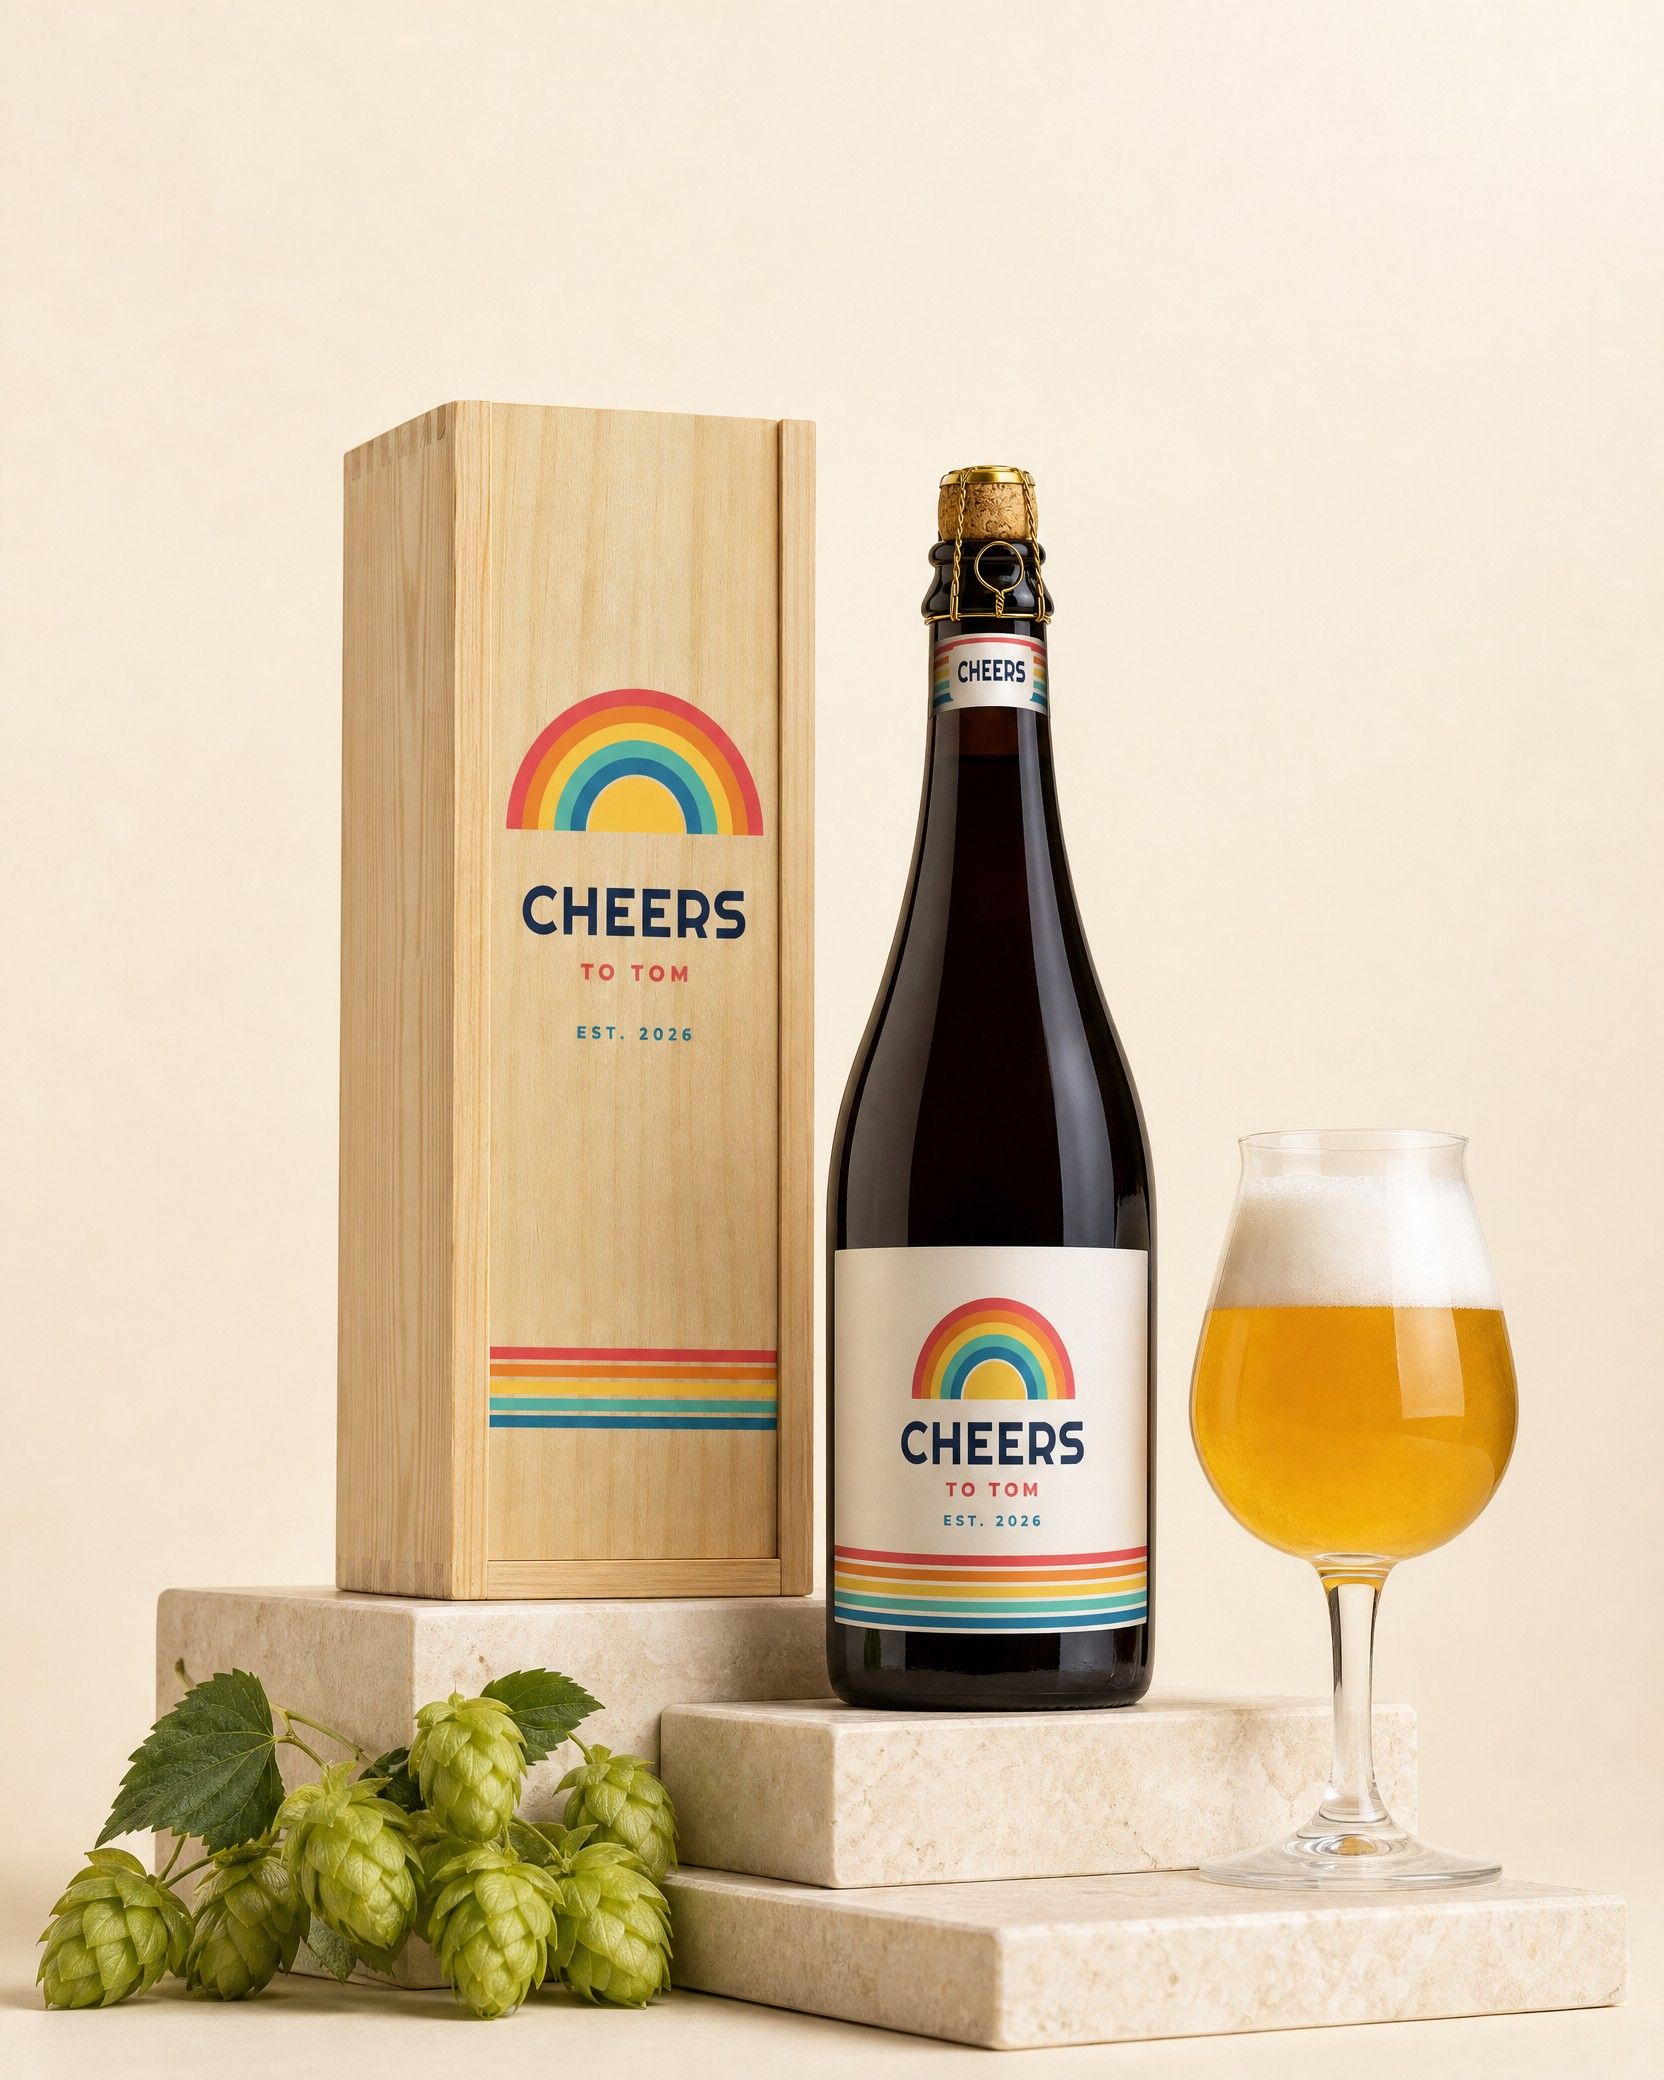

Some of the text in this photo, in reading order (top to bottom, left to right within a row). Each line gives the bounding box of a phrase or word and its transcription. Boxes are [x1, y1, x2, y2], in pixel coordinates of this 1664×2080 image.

[957, 659, 1026, 683] CHEERS
[522, 884, 746, 939] CHEERS
[580, 963, 689, 982] TO TOM
[576, 1025, 693, 1041] EST. 2026
[900, 1420, 1085, 1465] CHEERS
[945, 1482, 1038, 1498] TO TOM
[943, 1514, 1042, 1527] EST. 2026
